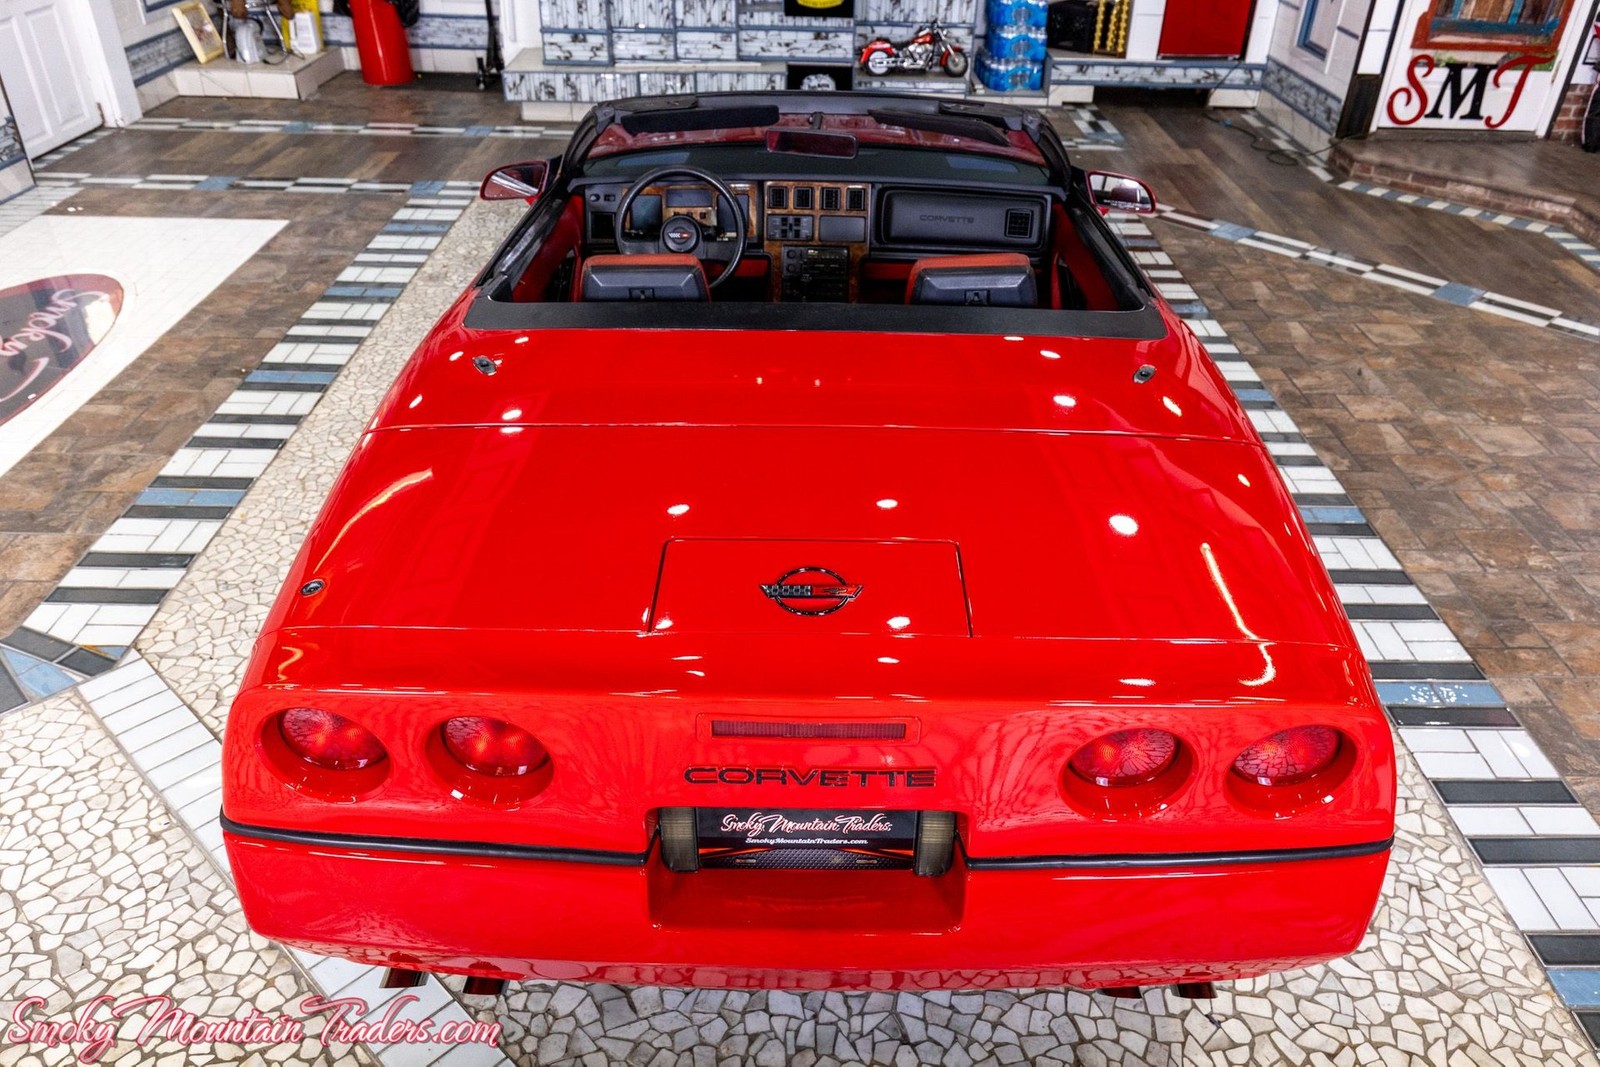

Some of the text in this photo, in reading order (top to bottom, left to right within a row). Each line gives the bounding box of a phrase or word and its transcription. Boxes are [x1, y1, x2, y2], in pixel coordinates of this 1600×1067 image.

[1387, 54, 1555, 129] SMT
[919, 214, 975, 224] CORVETTE
[683, 765, 938, 788] CORVETTE
[720, 812, 765, 837] Smoky
[762, 814, 840, 833] Mountain
[745, 837, 868, 845] SmokyMountainTraders.com
